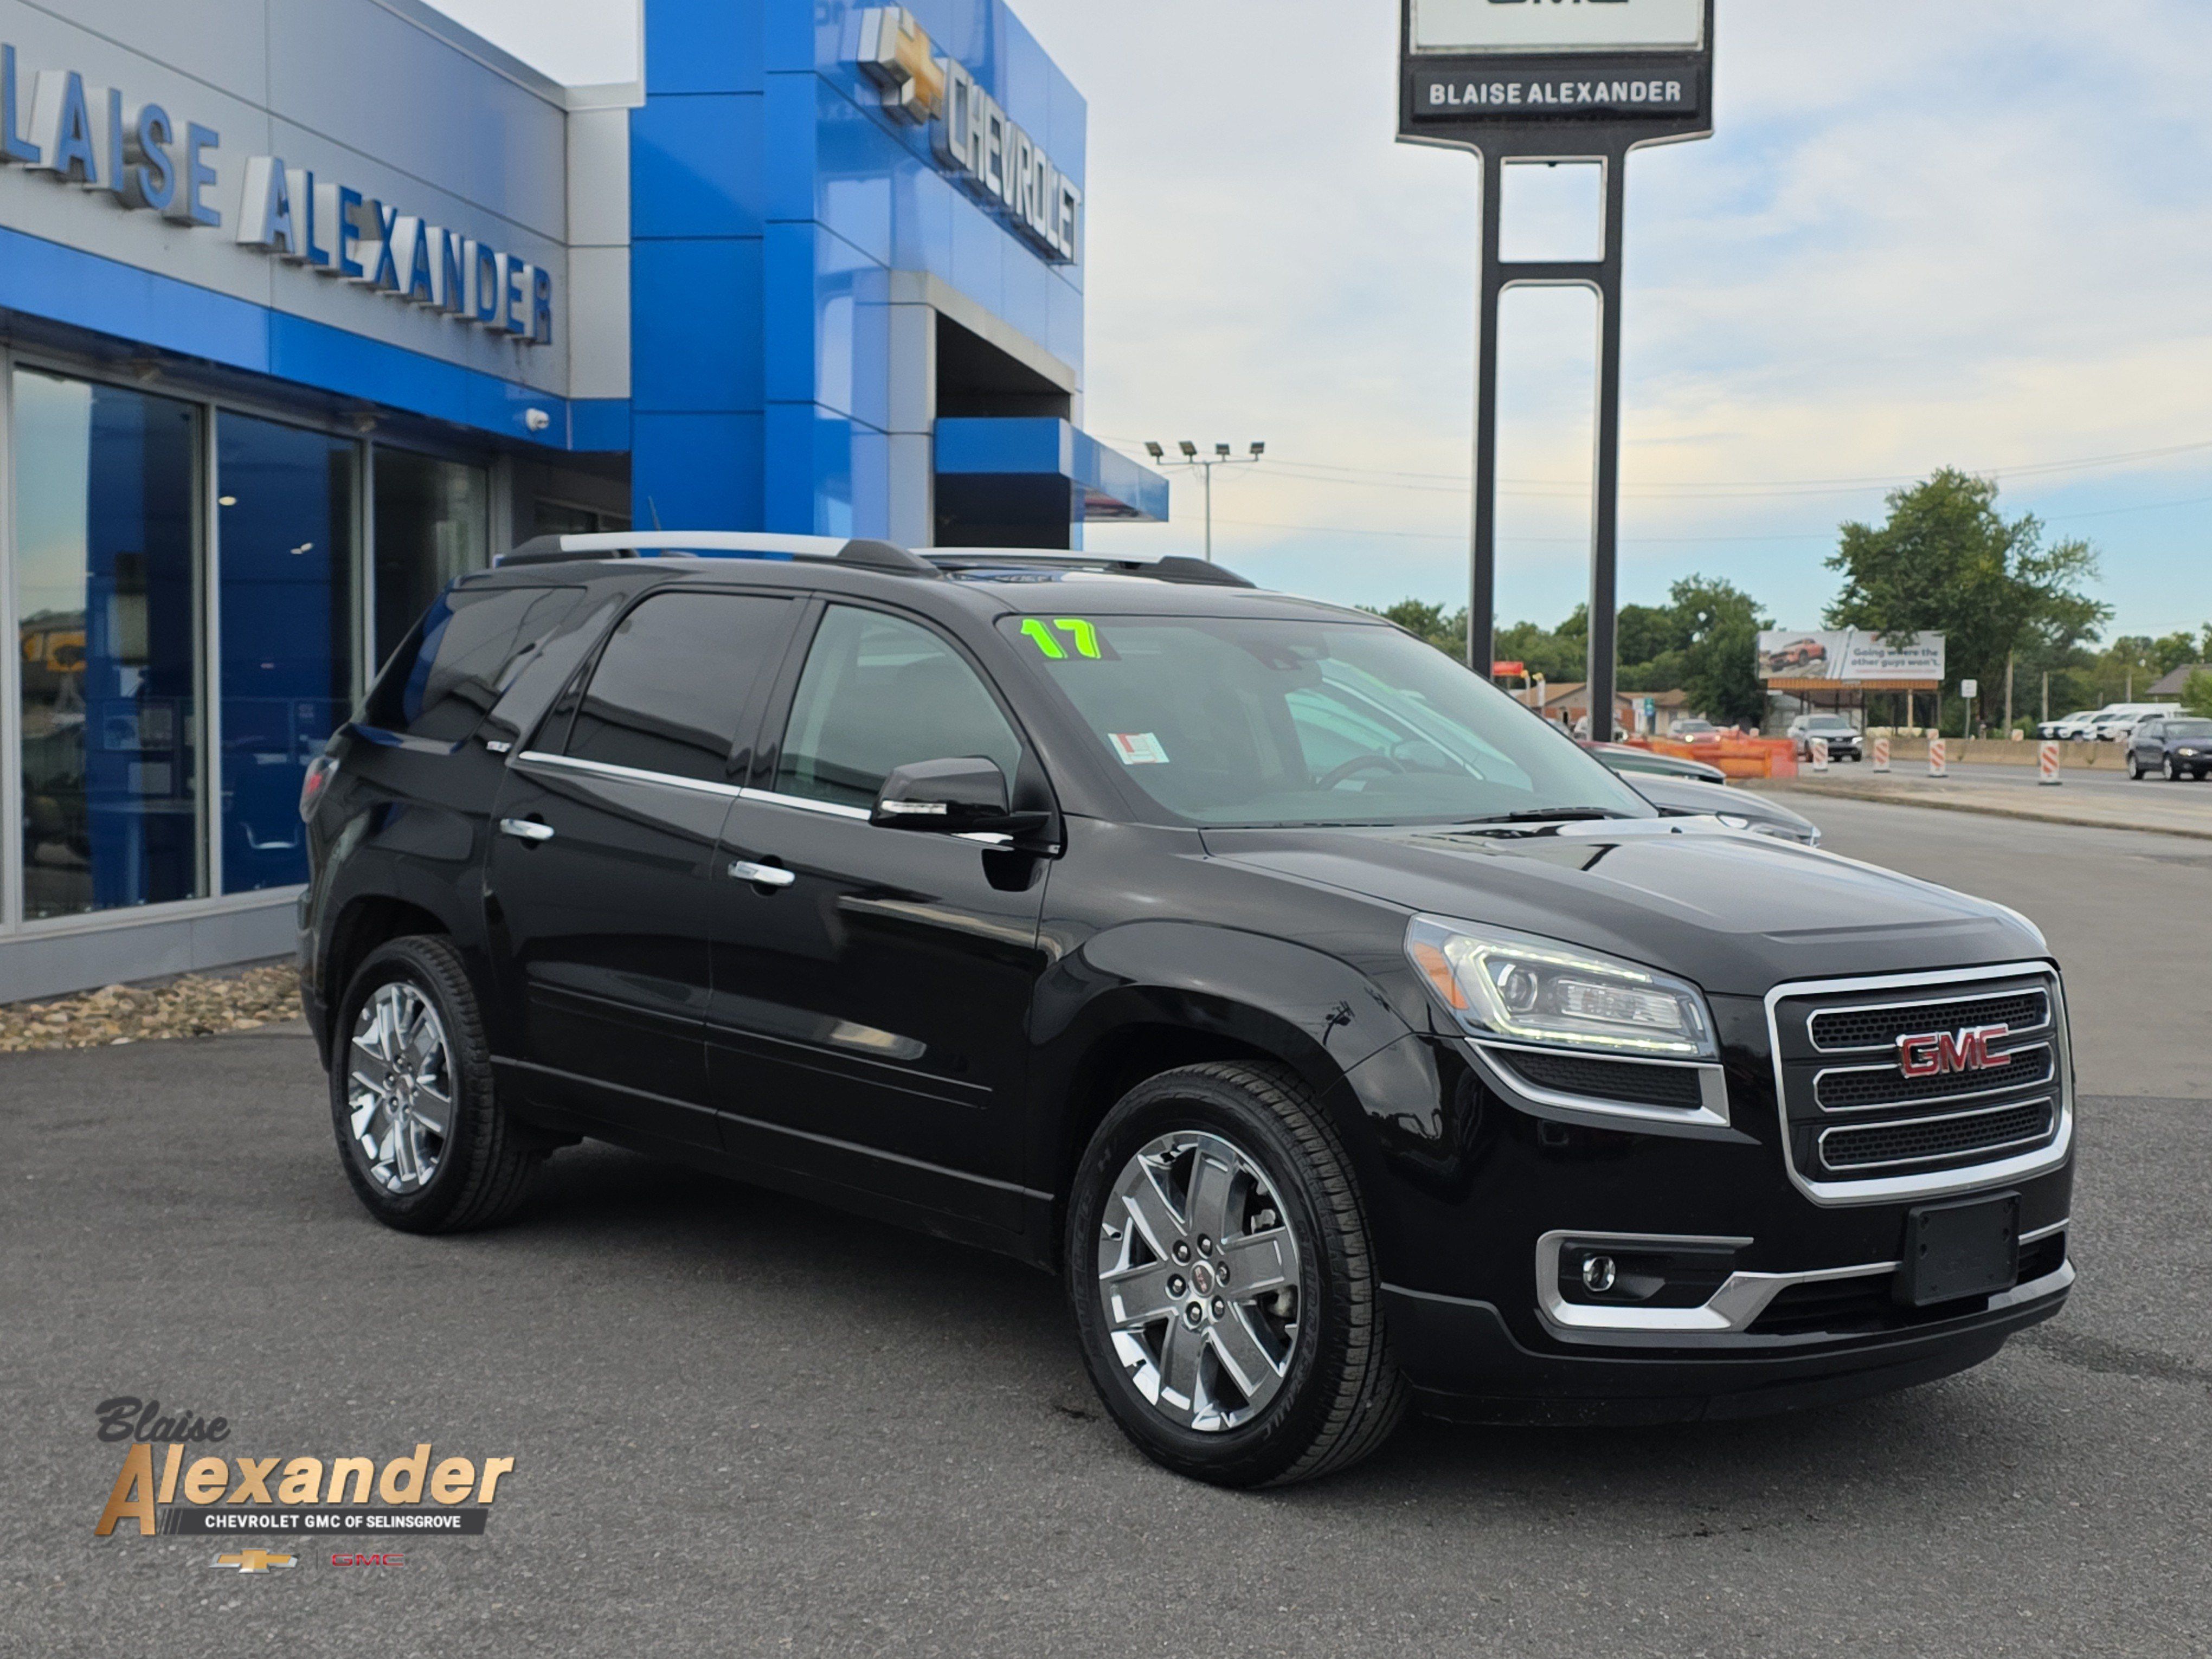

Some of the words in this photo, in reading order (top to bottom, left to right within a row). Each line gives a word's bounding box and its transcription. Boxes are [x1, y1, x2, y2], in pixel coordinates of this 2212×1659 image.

[1429, 83, 1521, 105] BLAISE
[1527, 81, 1681, 104] ALEXANDER
[941, 57, 1083, 263] CHEVROLET
[239, 156, 552, 346] ALEXANDER
[1021, 618, 1101, 659] 17
[1853, 648, 1885, 658] Going
[1851, 658, 1879, 666] other
[1881, 659, 1905, 667] guys
[1896, 1023, 2011, 1078] GMC
